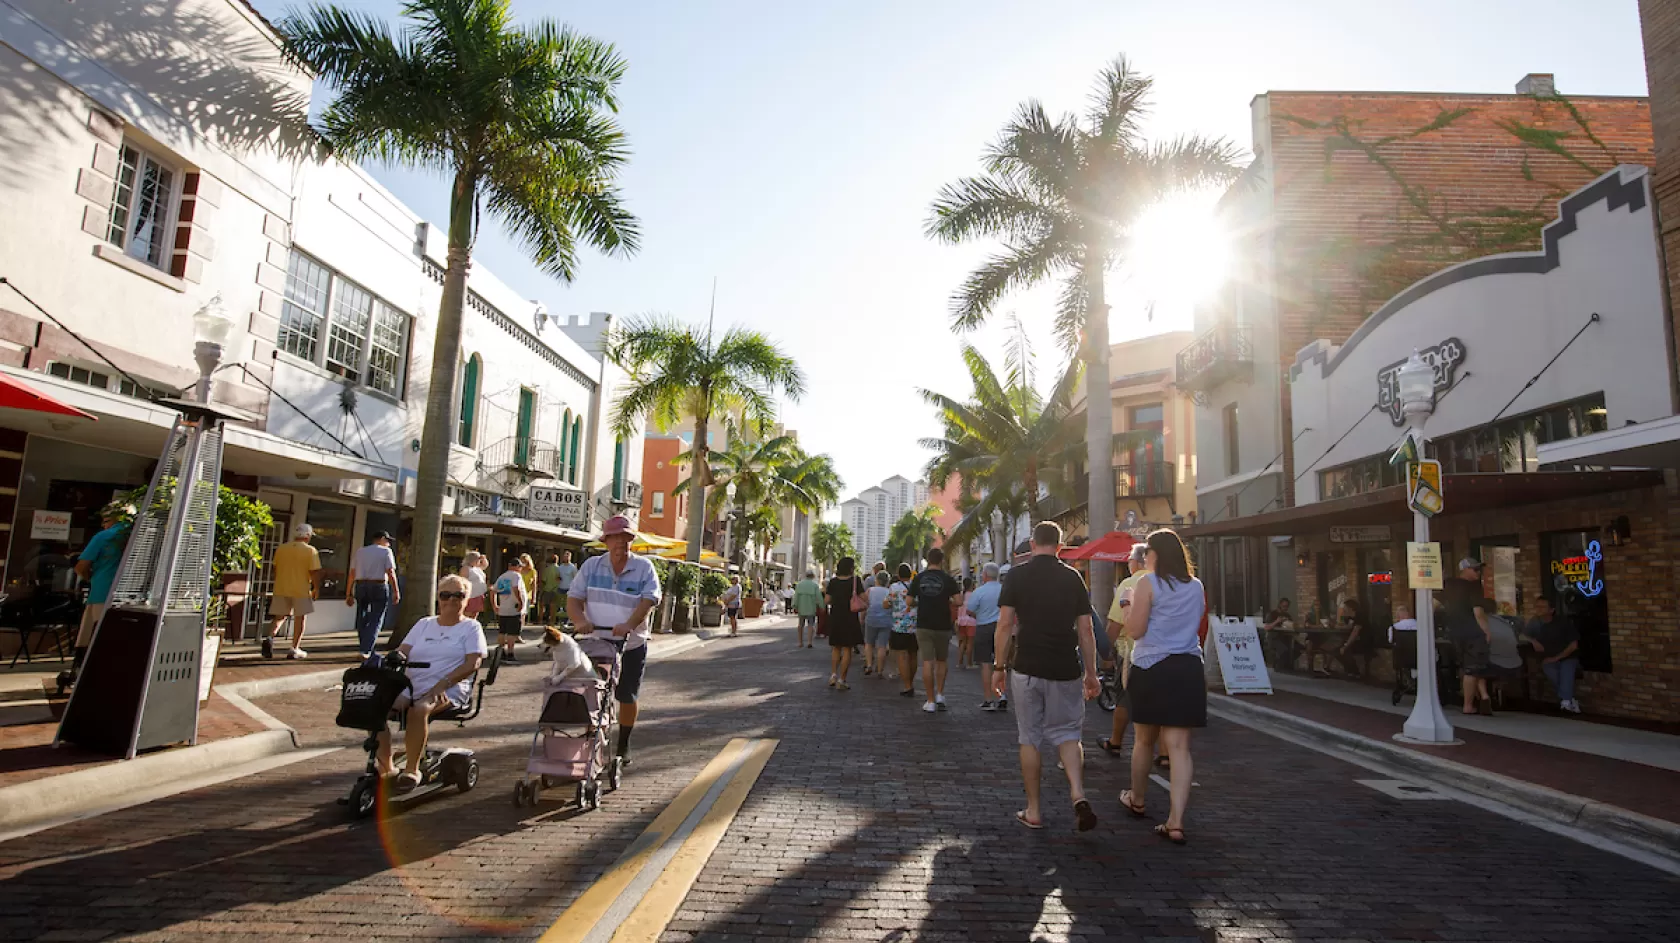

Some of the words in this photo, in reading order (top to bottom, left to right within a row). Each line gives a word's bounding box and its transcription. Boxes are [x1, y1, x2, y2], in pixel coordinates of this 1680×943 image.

[534, 490, 582, 504] CABOS
[533, 504, 580, 514] CANTINA
[45, 515, 68, 525] Price
[1368, 574, 1391, 583] OPEN
[1231, 664, 1257, 672] Hiring!
